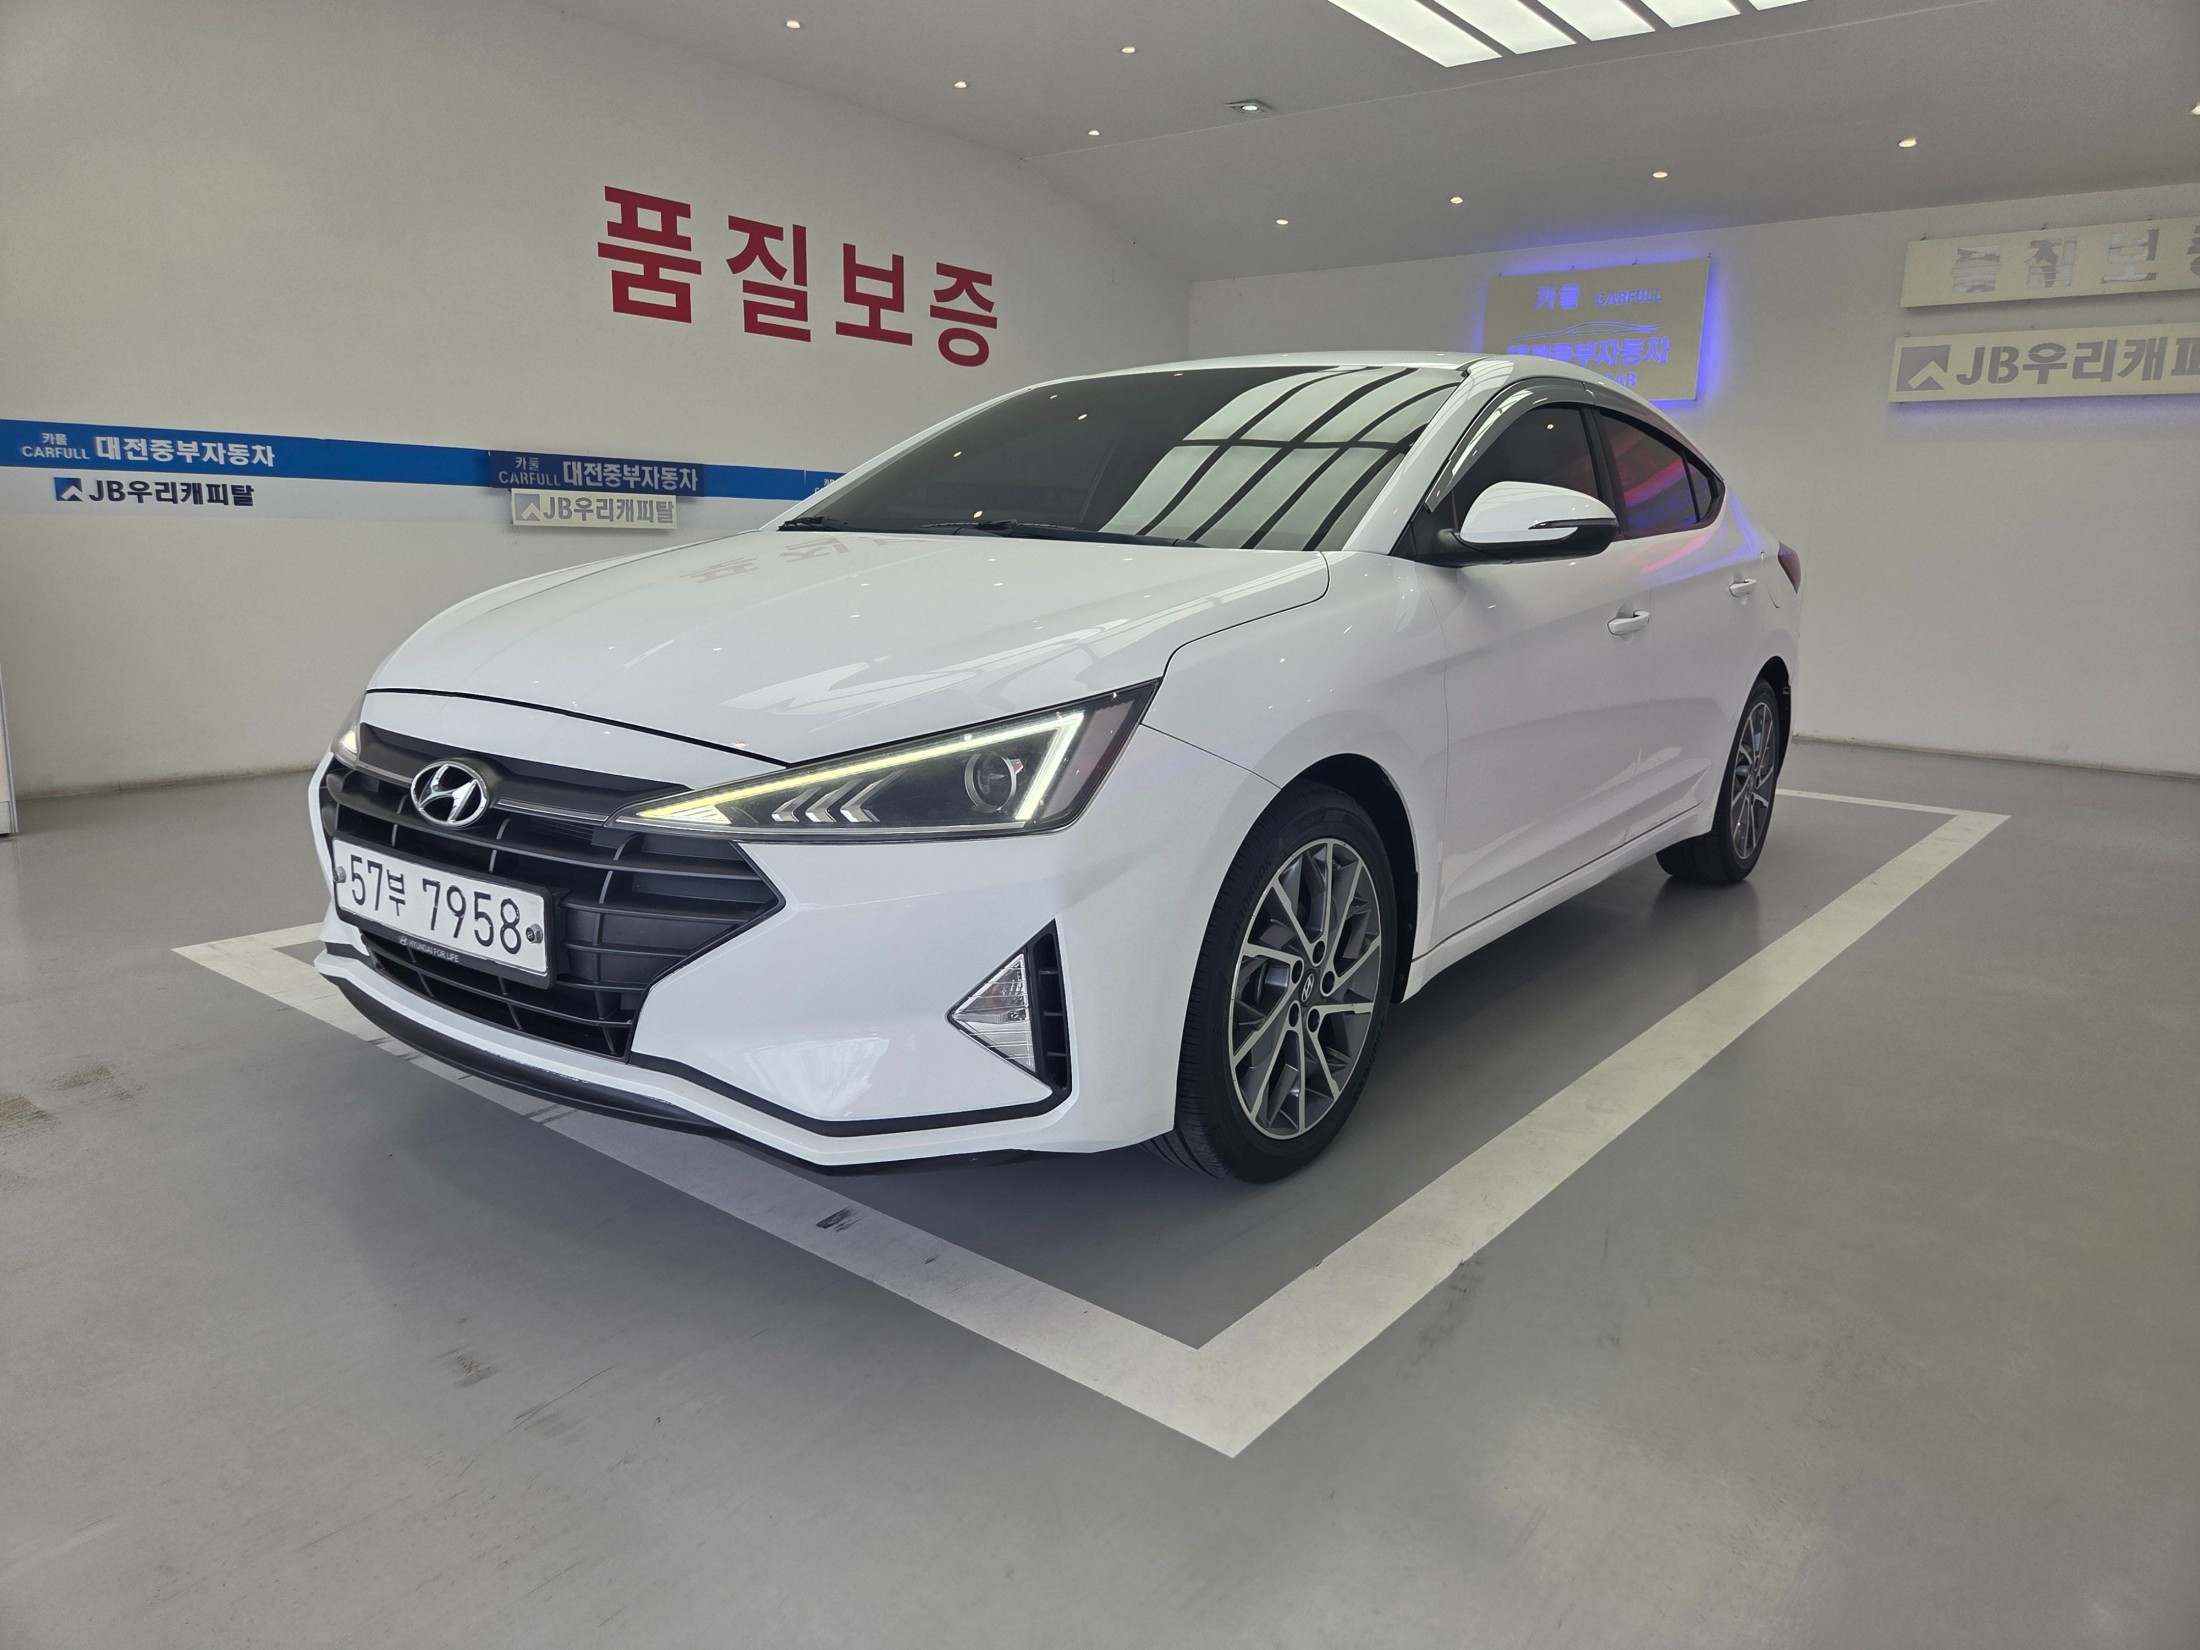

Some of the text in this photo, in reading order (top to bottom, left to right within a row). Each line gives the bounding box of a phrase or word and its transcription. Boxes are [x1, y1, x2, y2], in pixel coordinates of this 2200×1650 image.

[597, 185, 998, 367] 품질보증
[1595, 288, 1663, 306] CARFULL
[22, 446, 91, 460] CARFULL
[94, 436, 276, 468] 대전중부자동차
[499, 471, 561, 486] CARFULL
[562, 460, 699, 492] 대전중부자동차
[88, 480, 255, 507] JB우리캐피탈
[543, 496, 675, 524] JB우리캐피탈
[350, 854, 522, 955] 57부 7958
[433, 947, 445, 959] FOR
[446, 951, 460, 963] LIFE
